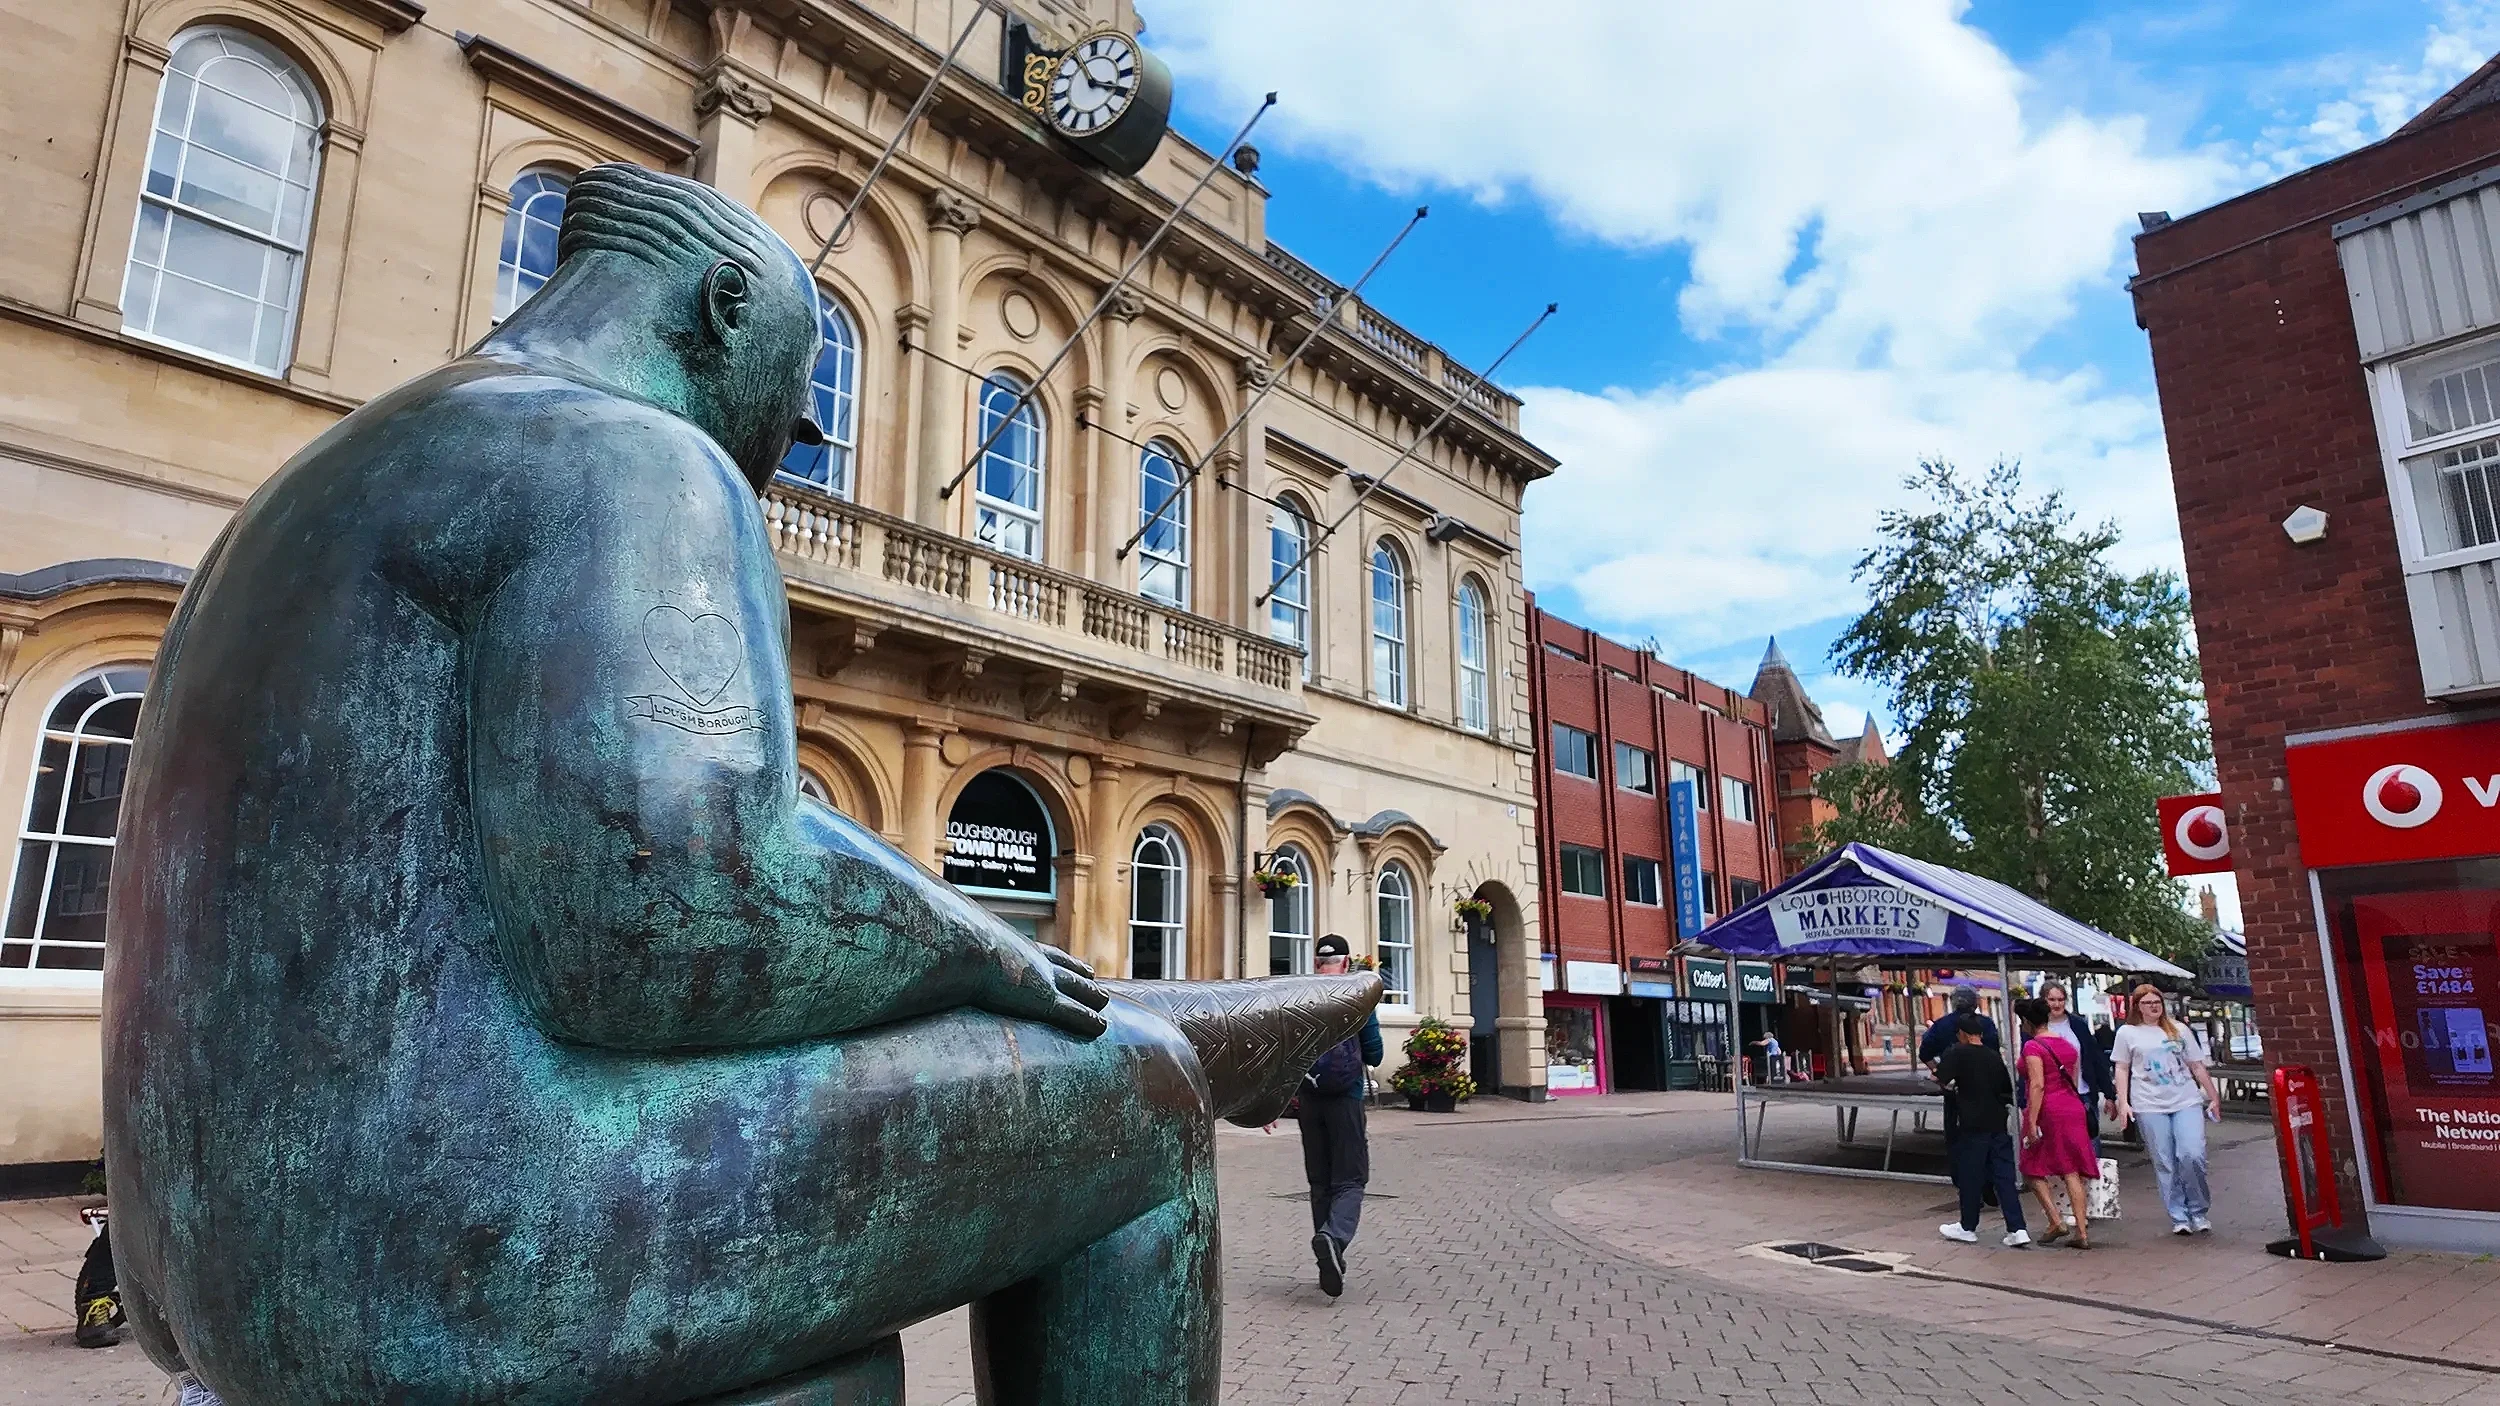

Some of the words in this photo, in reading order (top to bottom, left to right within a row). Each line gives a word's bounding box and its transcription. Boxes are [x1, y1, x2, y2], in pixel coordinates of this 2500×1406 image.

[654, 704, 748, 729] LOUGHBOROUGH
[946, 821, 1037, 845] LOUGHBOROUGH
[946, 837, 995, 857] TOWN
[997, 843, 1036, 861] HALL
[1799, 905, 1920, 931] MARKETS
[2413, 964, 2463, 979] Save
[2416, 1108, 2450, 1122] The
